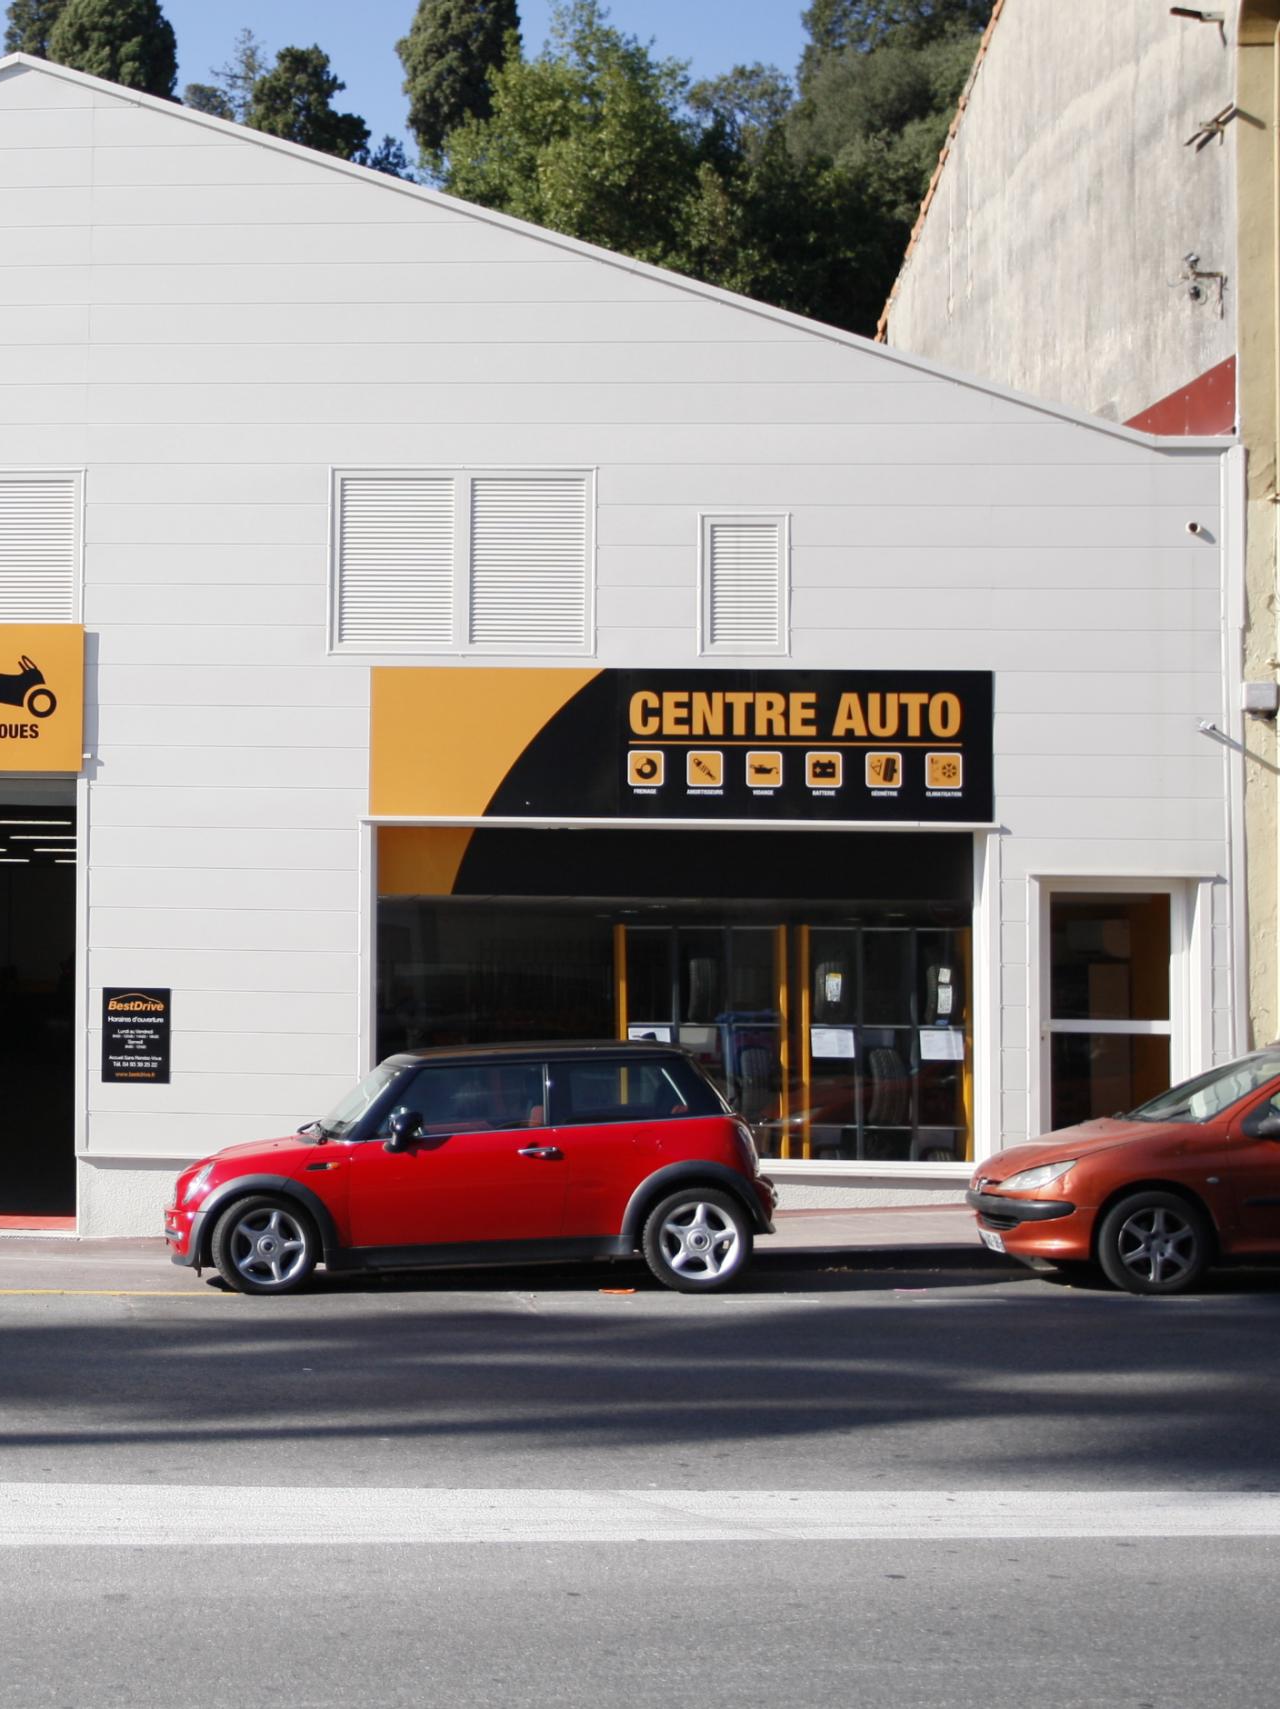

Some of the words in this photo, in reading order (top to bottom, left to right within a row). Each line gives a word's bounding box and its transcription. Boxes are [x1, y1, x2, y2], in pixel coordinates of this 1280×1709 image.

[628, 690, 817, 736] CENTRE
[832, 692, 962, 738] AUTO
[108, 1000, 165, 1011] BestDrive
